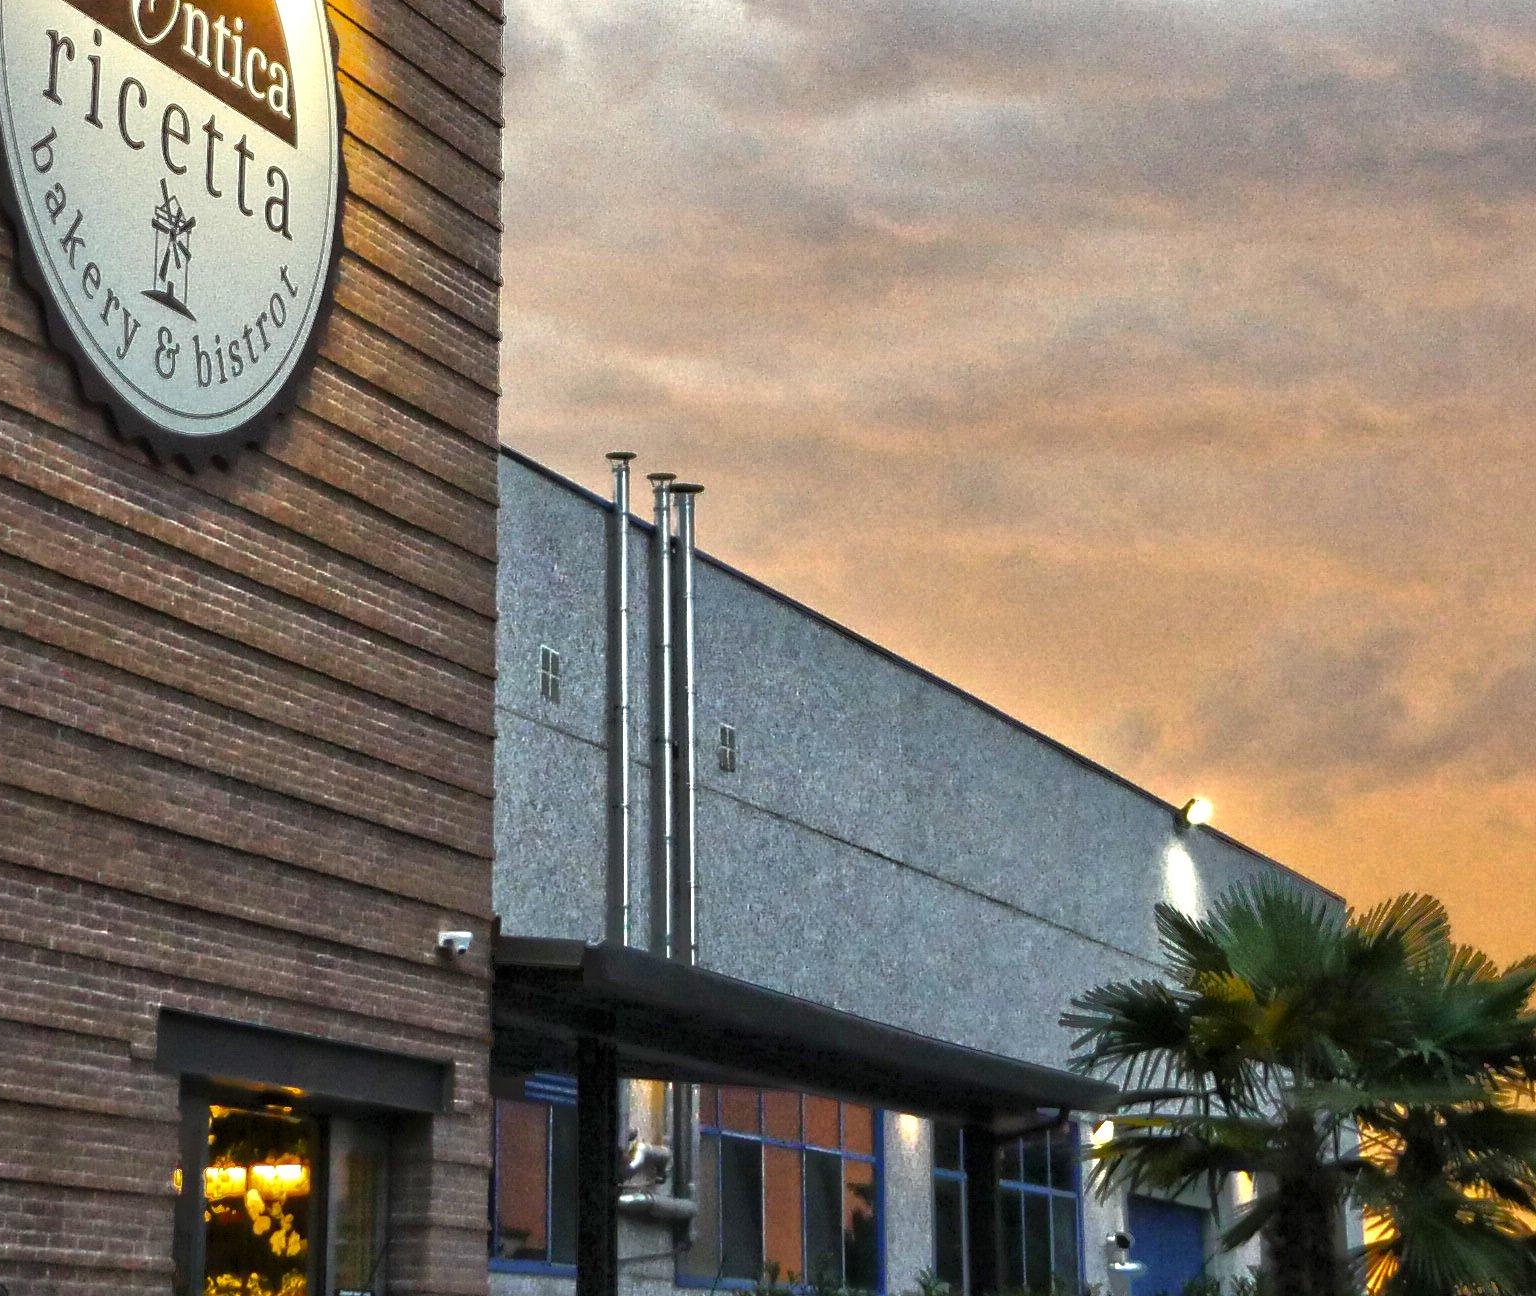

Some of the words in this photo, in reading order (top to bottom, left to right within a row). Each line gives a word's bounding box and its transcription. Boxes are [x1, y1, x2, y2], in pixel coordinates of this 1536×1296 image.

[41, 28, 294, 242] ricetta
[30, 126, 142, 360] bakery
[153, 325, 181, 381] &
[192, 264, 299, 389] bistrot
